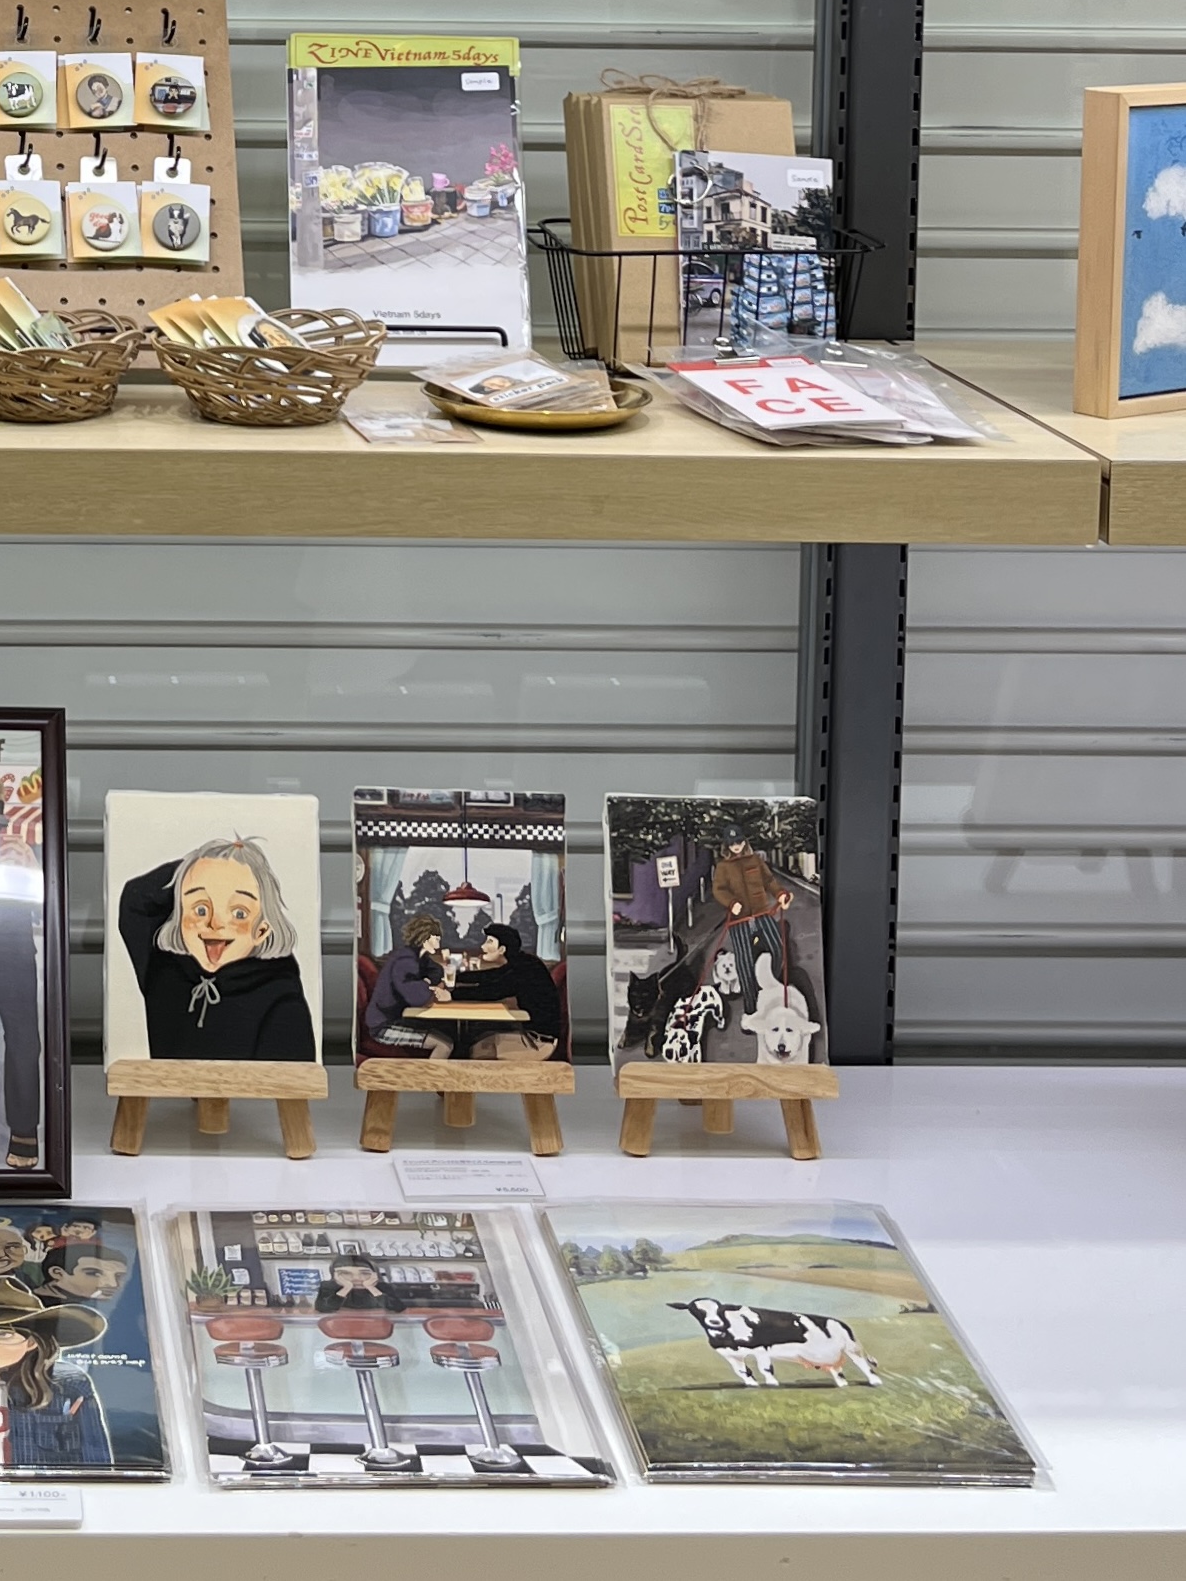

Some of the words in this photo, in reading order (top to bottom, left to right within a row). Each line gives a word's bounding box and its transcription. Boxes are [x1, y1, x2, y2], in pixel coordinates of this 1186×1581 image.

[355, 39, 450, 63] Vietnam
[372, 309, 411, 319] Vietnam
[492, 386, 534, 402] sticker
[536, 377, 565, 390] pack
